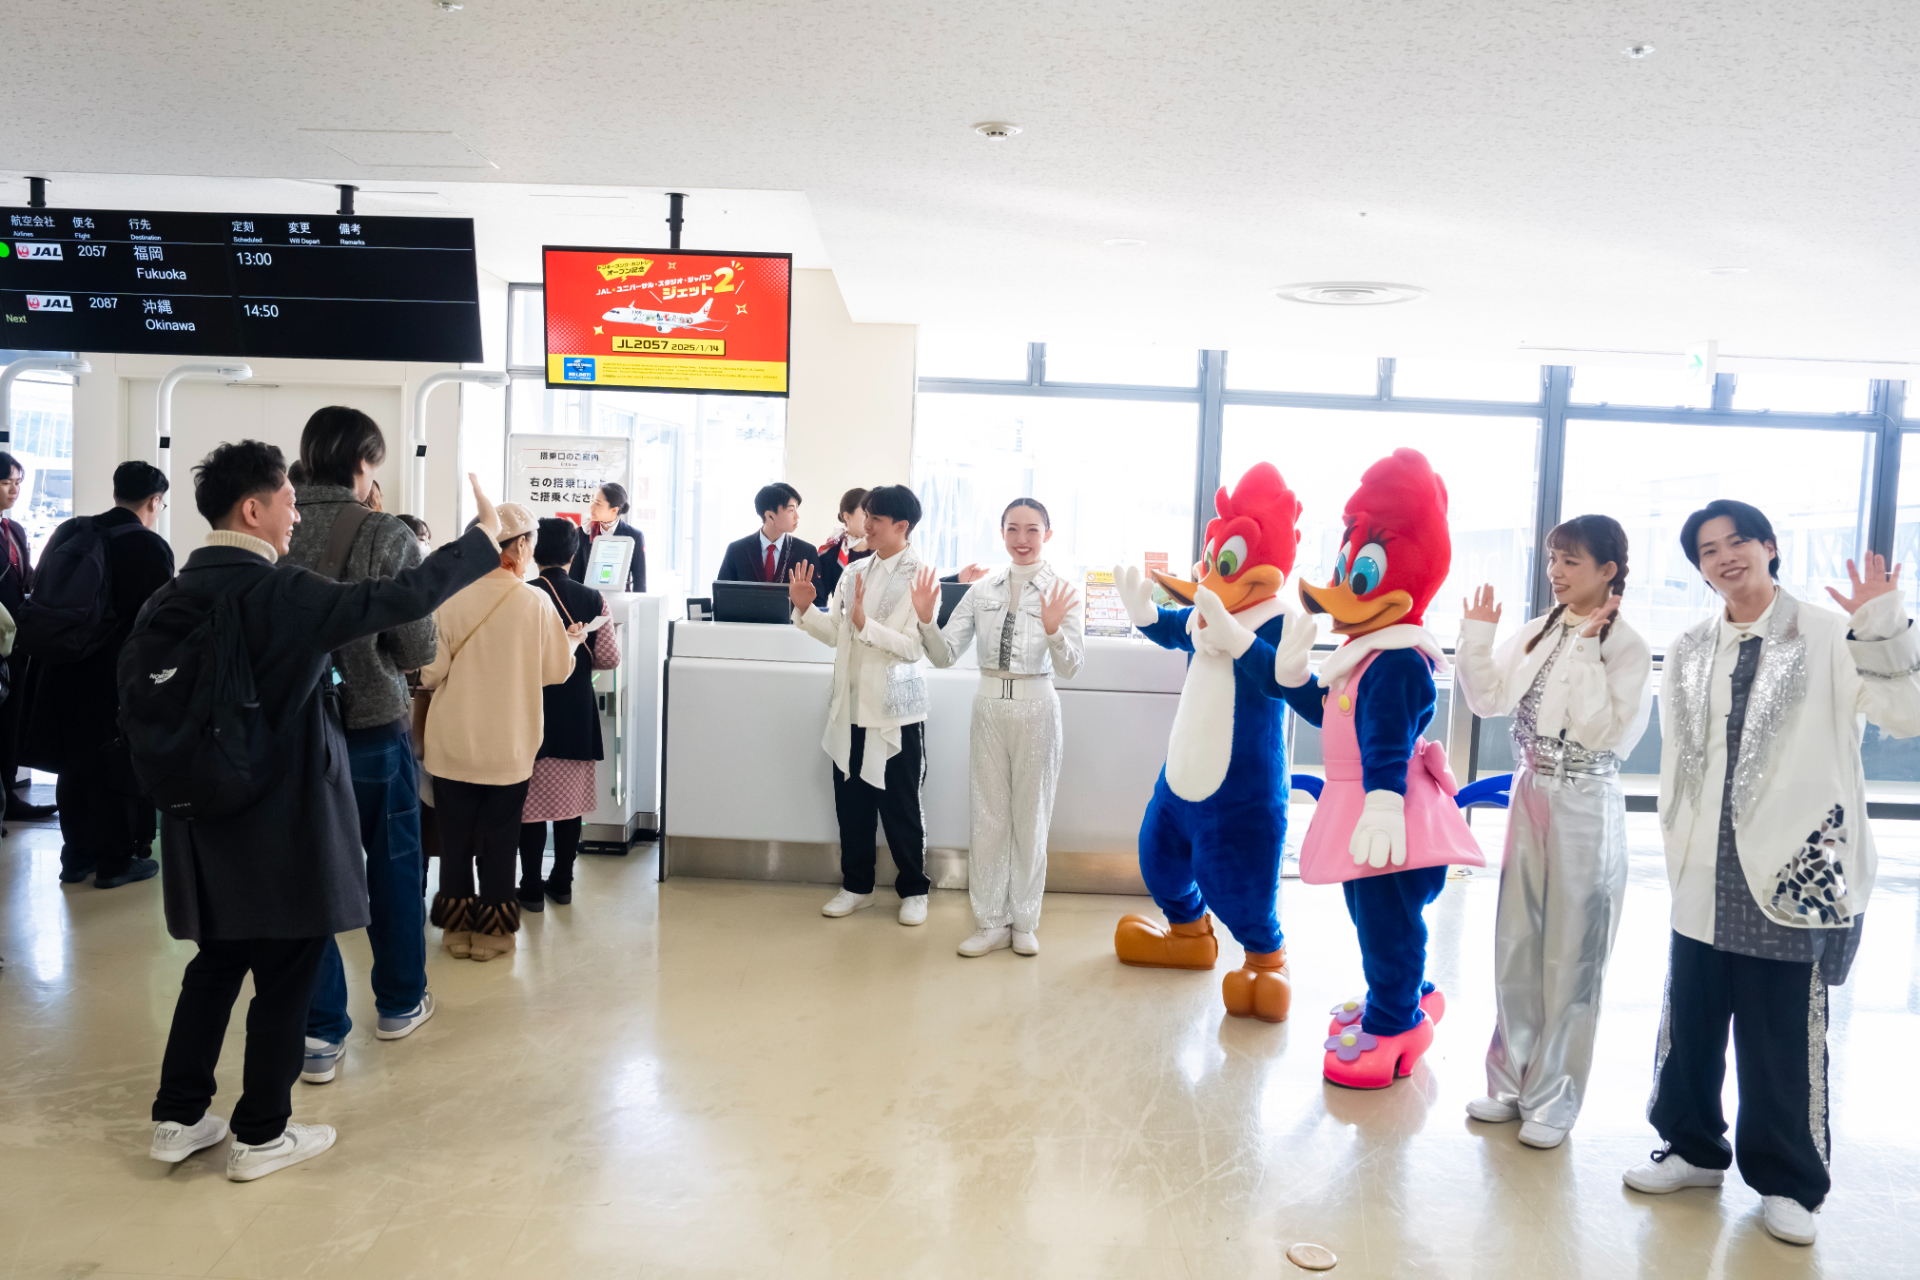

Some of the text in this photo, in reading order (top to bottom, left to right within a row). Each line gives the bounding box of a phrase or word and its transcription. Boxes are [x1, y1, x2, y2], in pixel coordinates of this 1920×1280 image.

[10, 215, 55, 227] 航空会社
[72, 217, 95, 229] 便名
[128, 218, 151, 230] 行先
[232, 221, 254, 232] 定刻
[288, 222, 311, 234] 変更
[339, 223, 361, 235] 備考
[301, 238, 320, 246] Depart
[32, 247, 62, 257] JAL
[77, 245, 107, 257] 2057
[133, 245, 163, 261] 福岡
[236, 252, 272, 265] 13:00
[136, 268, 187, 280] Fukuoka
[43, 298, 72, 309] JAL
[89, 298, 117, 309] 2087
[143, 299, 173, 314] 沖縄
[243, 304, 279, 317] 14:50
[6, 314, 27, 323] Next
[145, 319, 196, 331] Okinawa
[617, 339, 719, 352] JL2057 2025/1/14
[540, 452, 599, 461] 搭乗口のご案内
[530, 491, 595, 503] ご搭乗くださ
